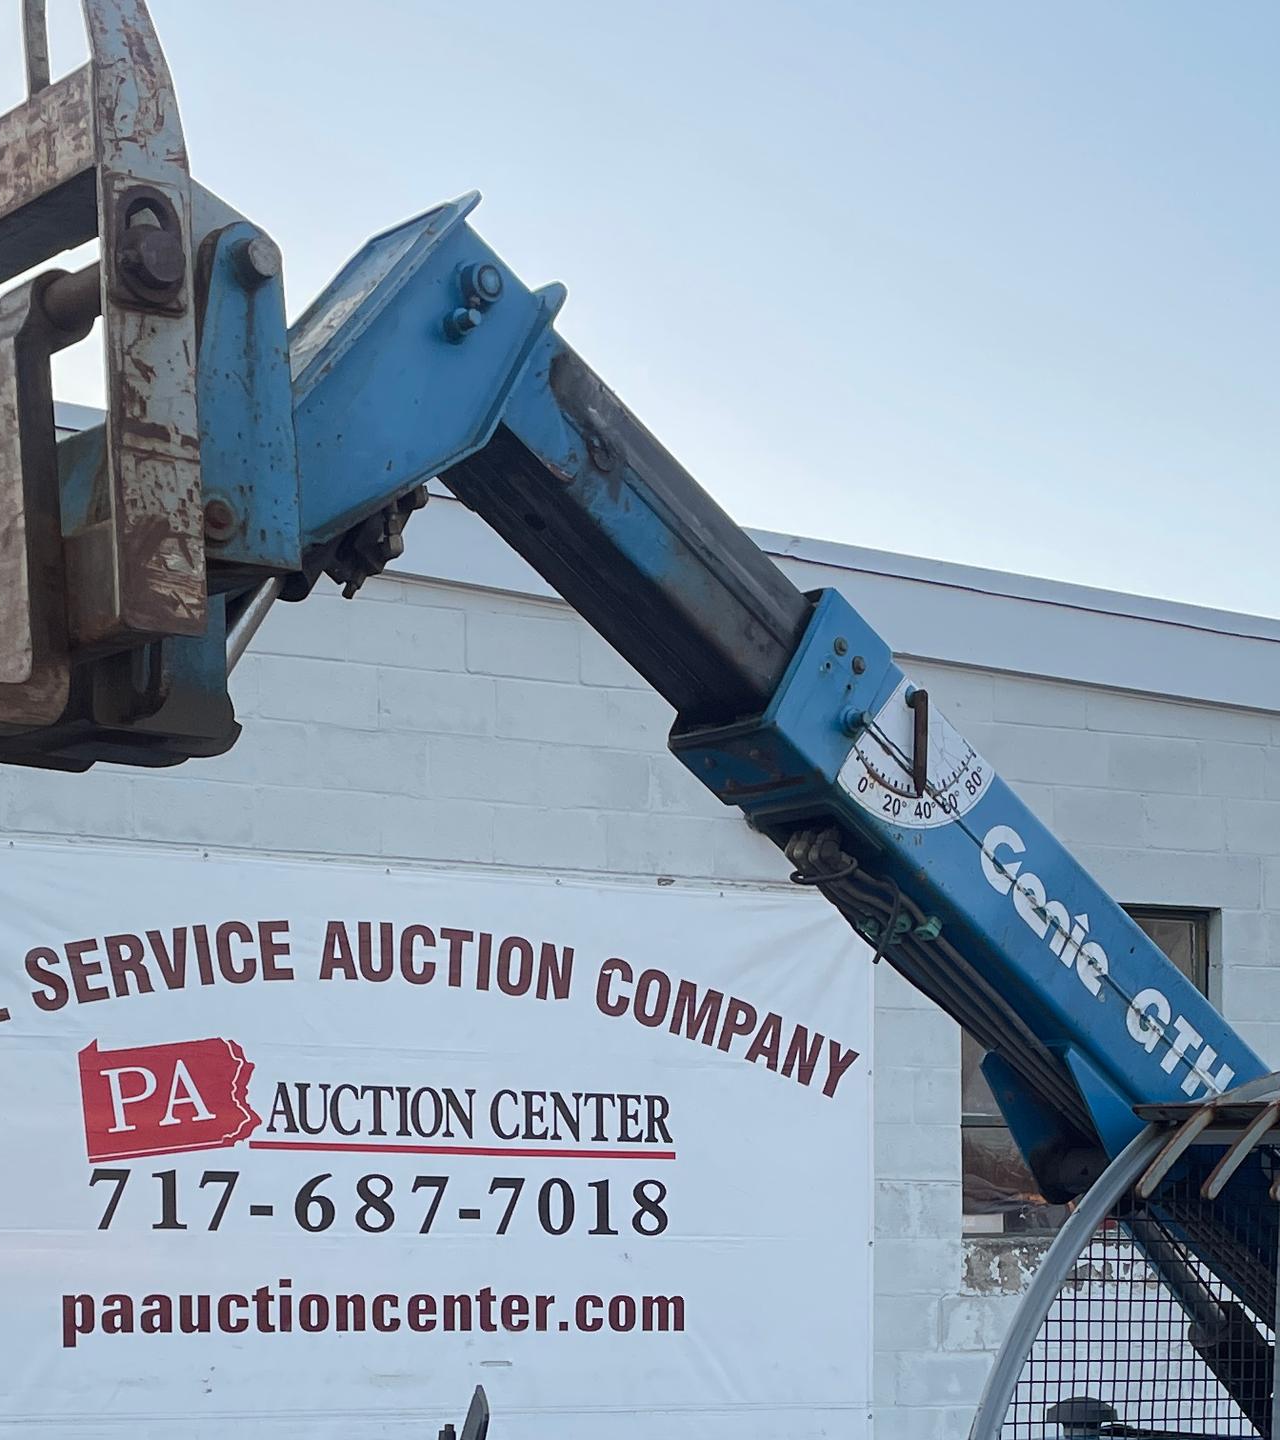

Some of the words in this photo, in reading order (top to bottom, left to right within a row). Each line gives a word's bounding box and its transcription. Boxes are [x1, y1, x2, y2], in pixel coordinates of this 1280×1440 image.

[980, 825, 1109, 997] Genie
[24, 920, 295, 1012] SERVICE
[318, 920, 575, 1001] AUCTION
[595, 957, 860, 1099] COMPANY
[100, 1059, 217, 1133] PA
[266, 1081, 477, 1140] AUCTION
[489, 1089, 674, 1144] CENTER
[88, 1167, 669, 1237] 717-687-7018
[63, 1279, 685, 1348] paauctioncenter.com
